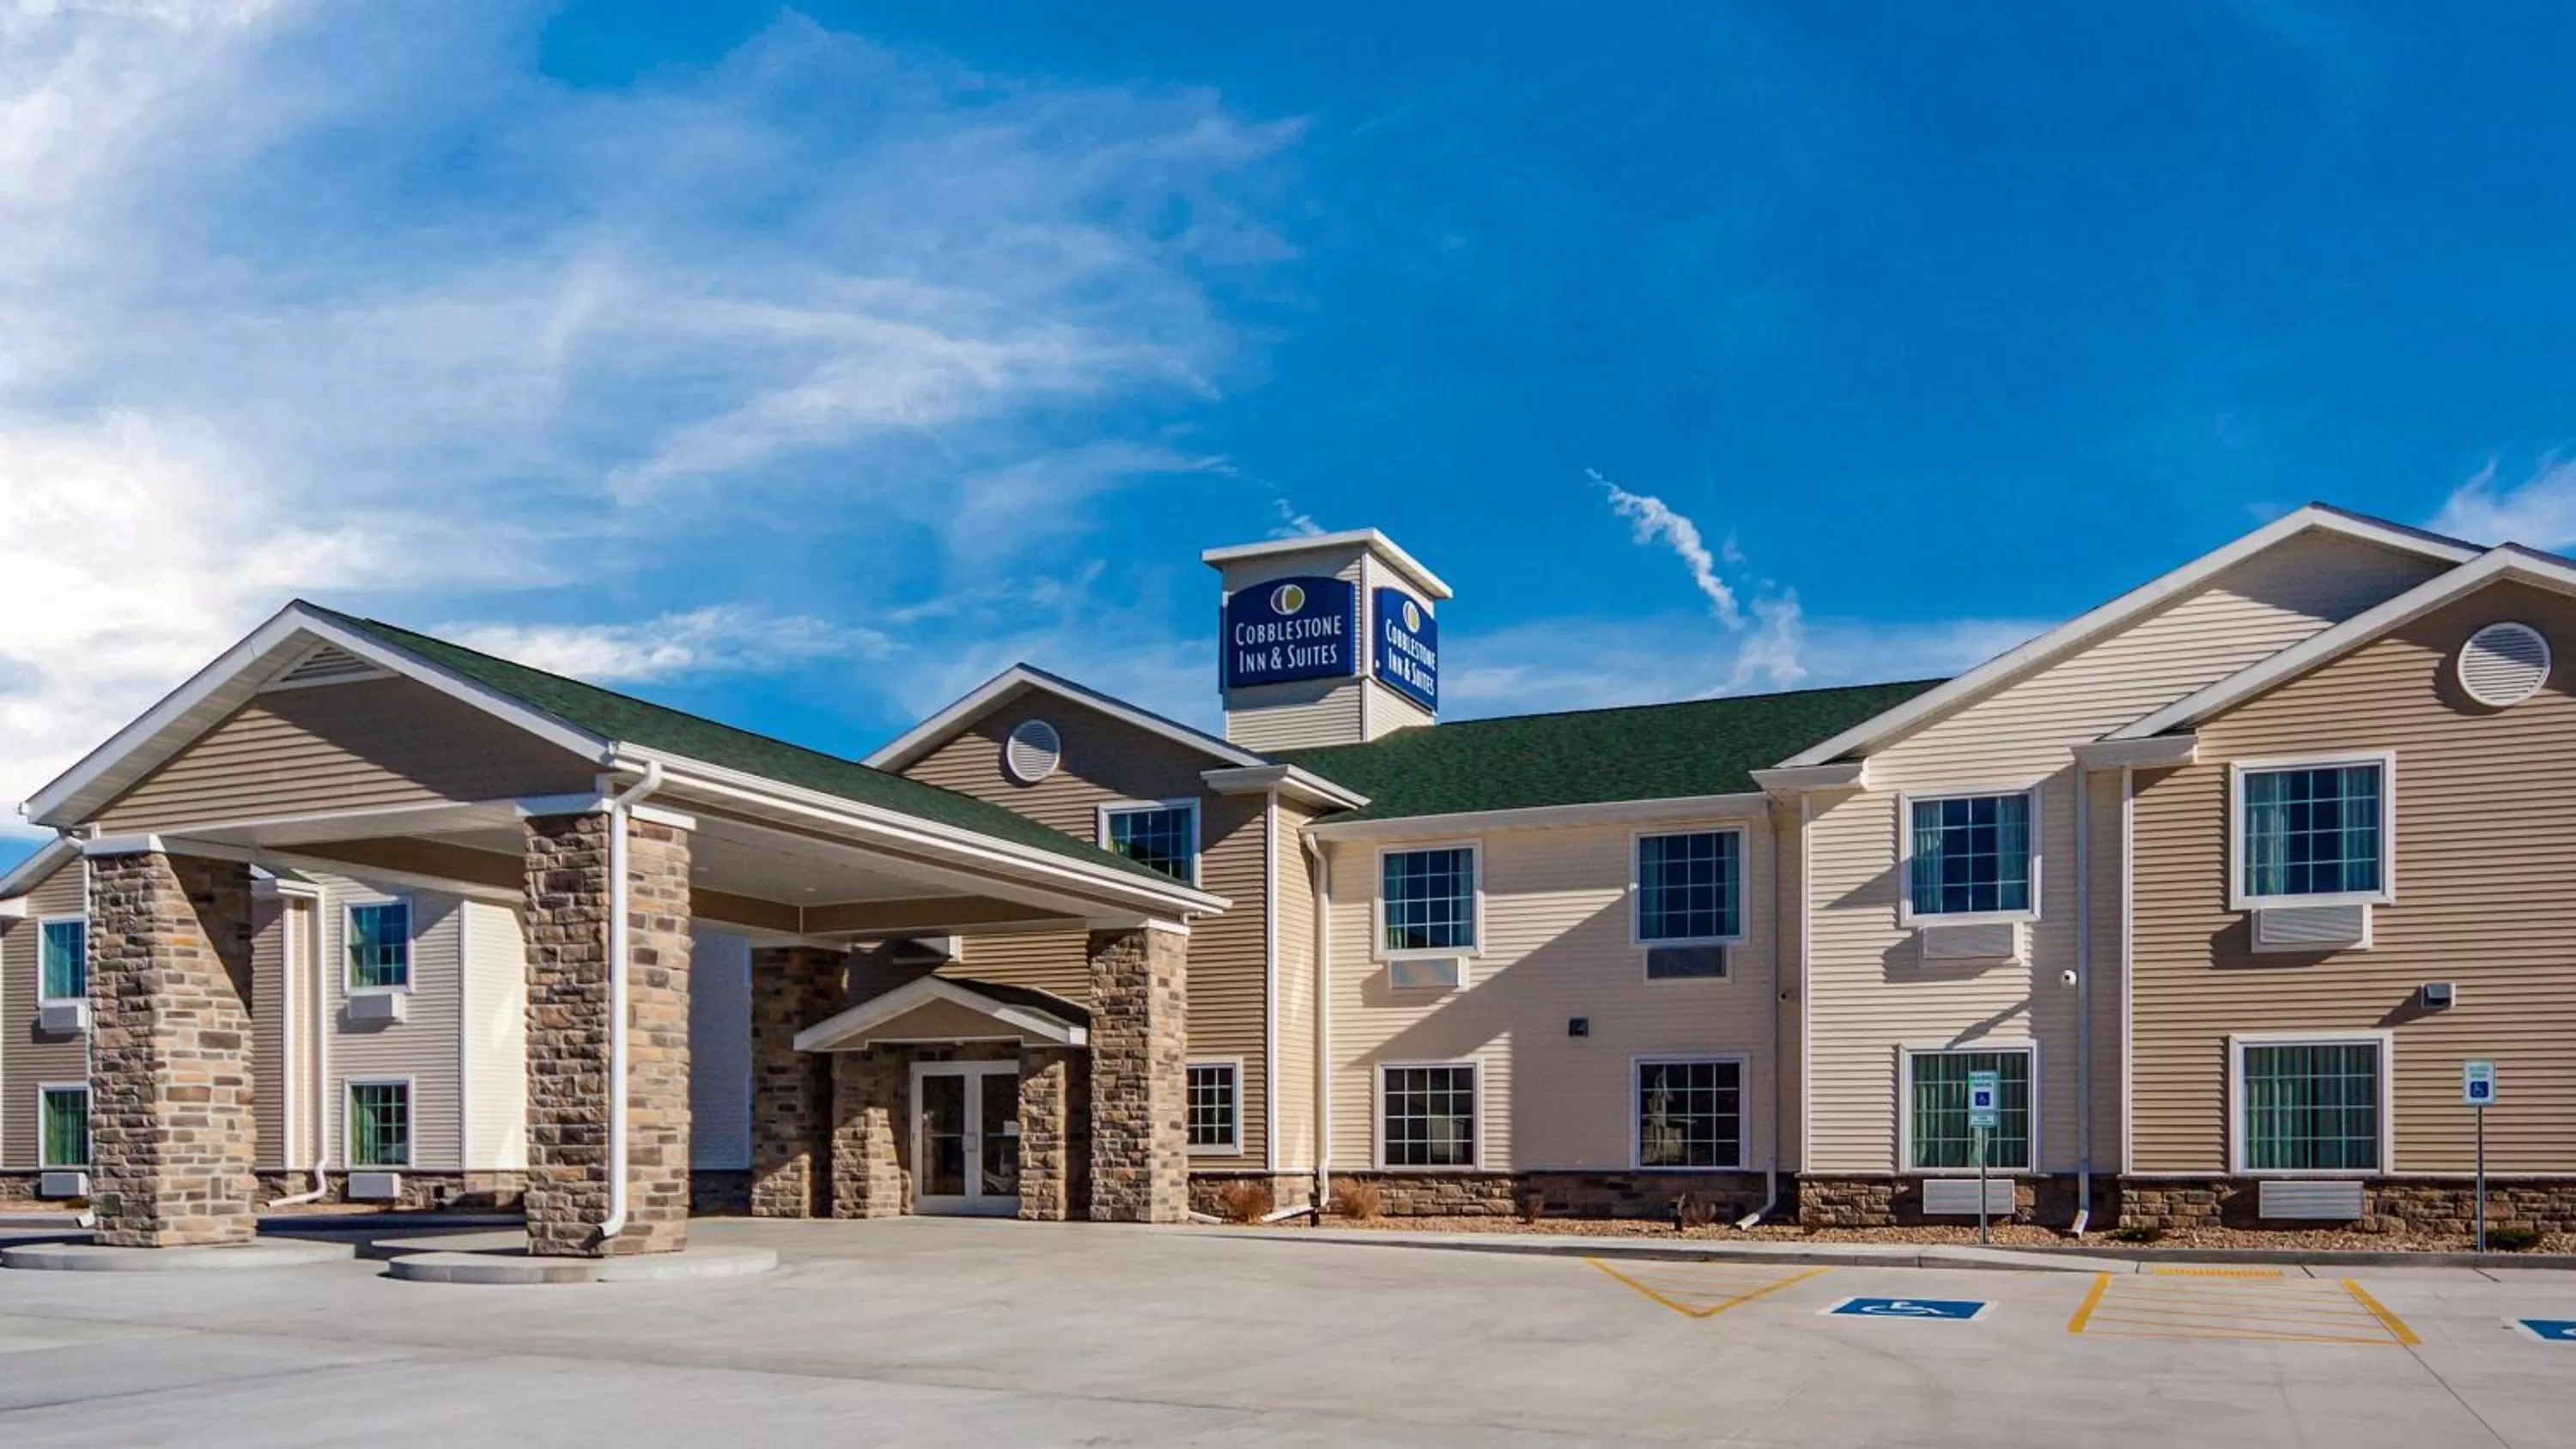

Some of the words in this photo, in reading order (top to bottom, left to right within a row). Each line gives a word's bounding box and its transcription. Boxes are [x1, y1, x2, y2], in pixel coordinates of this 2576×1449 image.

[1235, 615, 1342, 646] COBBLESTONE
[1385, 618, 1436, 671] COBBLESTONE
[1239, 650, 1266, 673] INN
[1270, 646, 1282, 670] &
[1287, 644, 1337, 668] SUITES
[1388, 647, 1402, 676] INN
[1404, 658, 1411, 682] &
